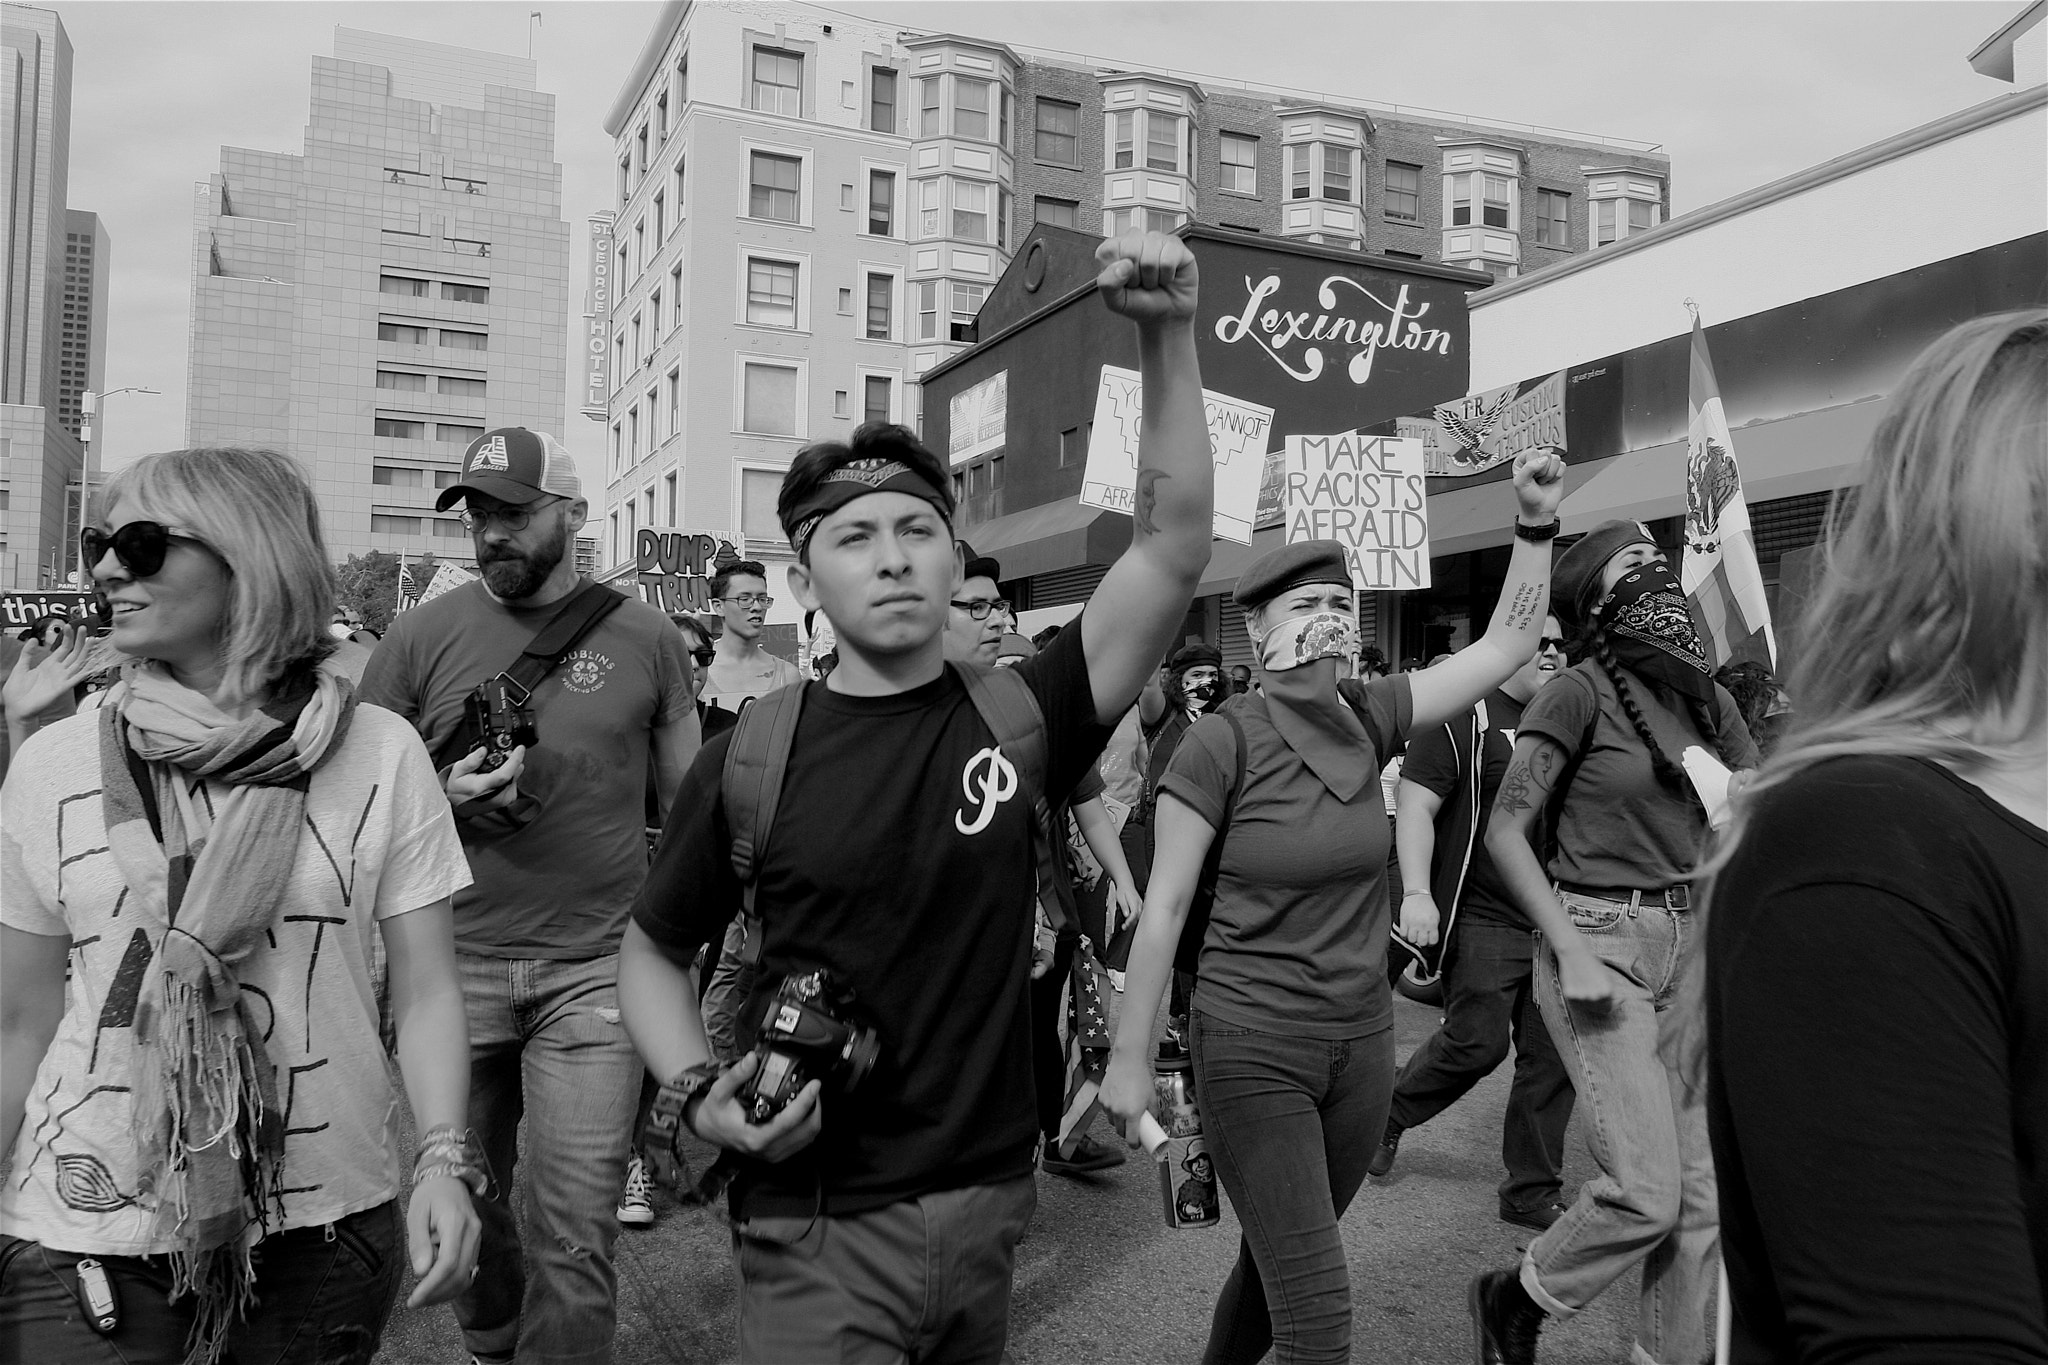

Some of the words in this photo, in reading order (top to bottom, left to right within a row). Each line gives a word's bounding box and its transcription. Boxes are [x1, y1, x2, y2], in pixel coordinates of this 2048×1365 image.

[594, 239, 608, 313] GEORGE
[1215, 275, 1451, 384] Lexington
[588, 320, 607, 405] HOTEL
[1204, 403, 1267, 438] CANNOT
[1502, 379, 1558, 421] CUSTOM
[1301, 436, 1404, 474] MAKE
[1495, 409, 1562, 461] TATTOOS
[1287, 472, 1423, 511] RACISTS
[1288, 508, 1427, 550] AFRAID
[637, 529, 716, 575] DUMP
[1349, 548, 1421, 589] AIN
[1, 597, 68, 624] this
[638, 572, 713, 613] TRUM
